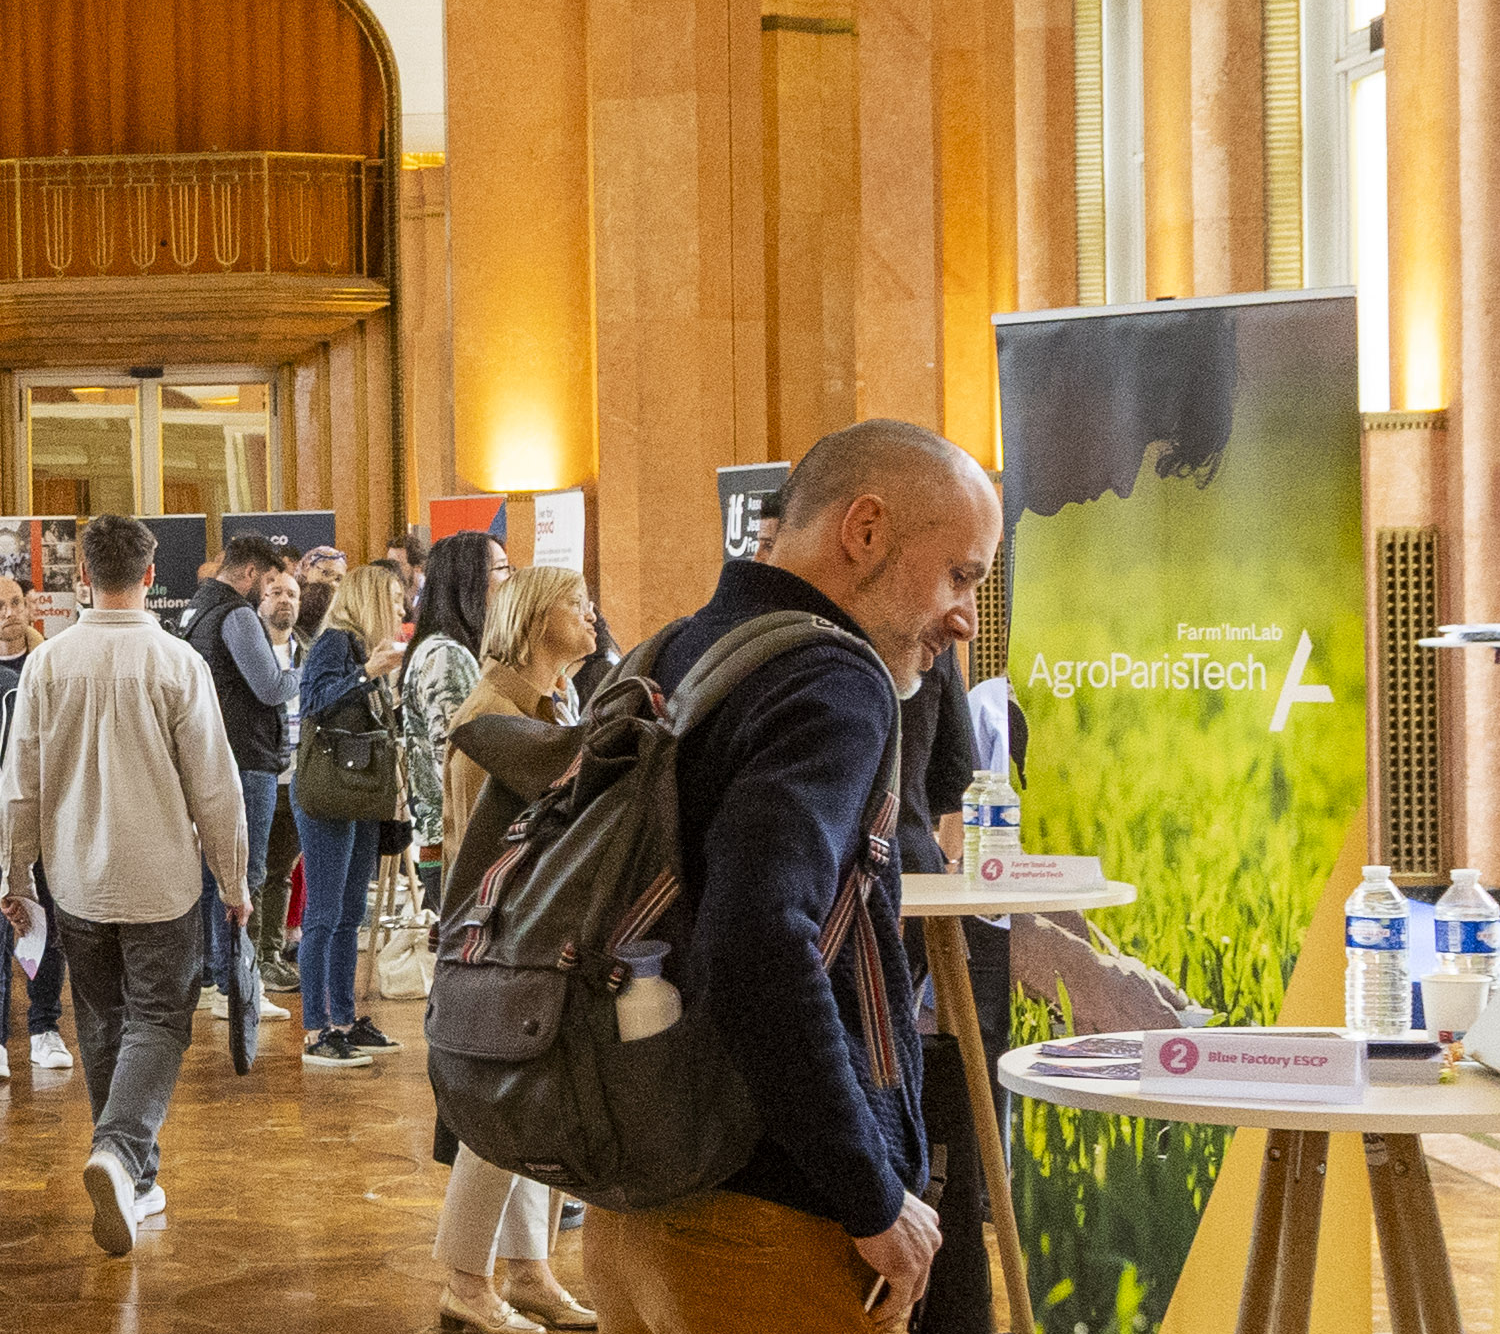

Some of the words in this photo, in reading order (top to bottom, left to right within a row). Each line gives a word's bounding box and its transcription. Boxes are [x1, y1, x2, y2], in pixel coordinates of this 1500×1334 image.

[1177, 623, 1283, 641] Farm'InnLab
[1028, 652, 1267, 698] AgroParisTech
[1170, 1043, 1187, 1069] 2
[1208, 1051, 1237, 1064] Blue
[1241, 1053, 1290, 1069] Factory
[1293, 1055, 1328, 1068] ESCP
